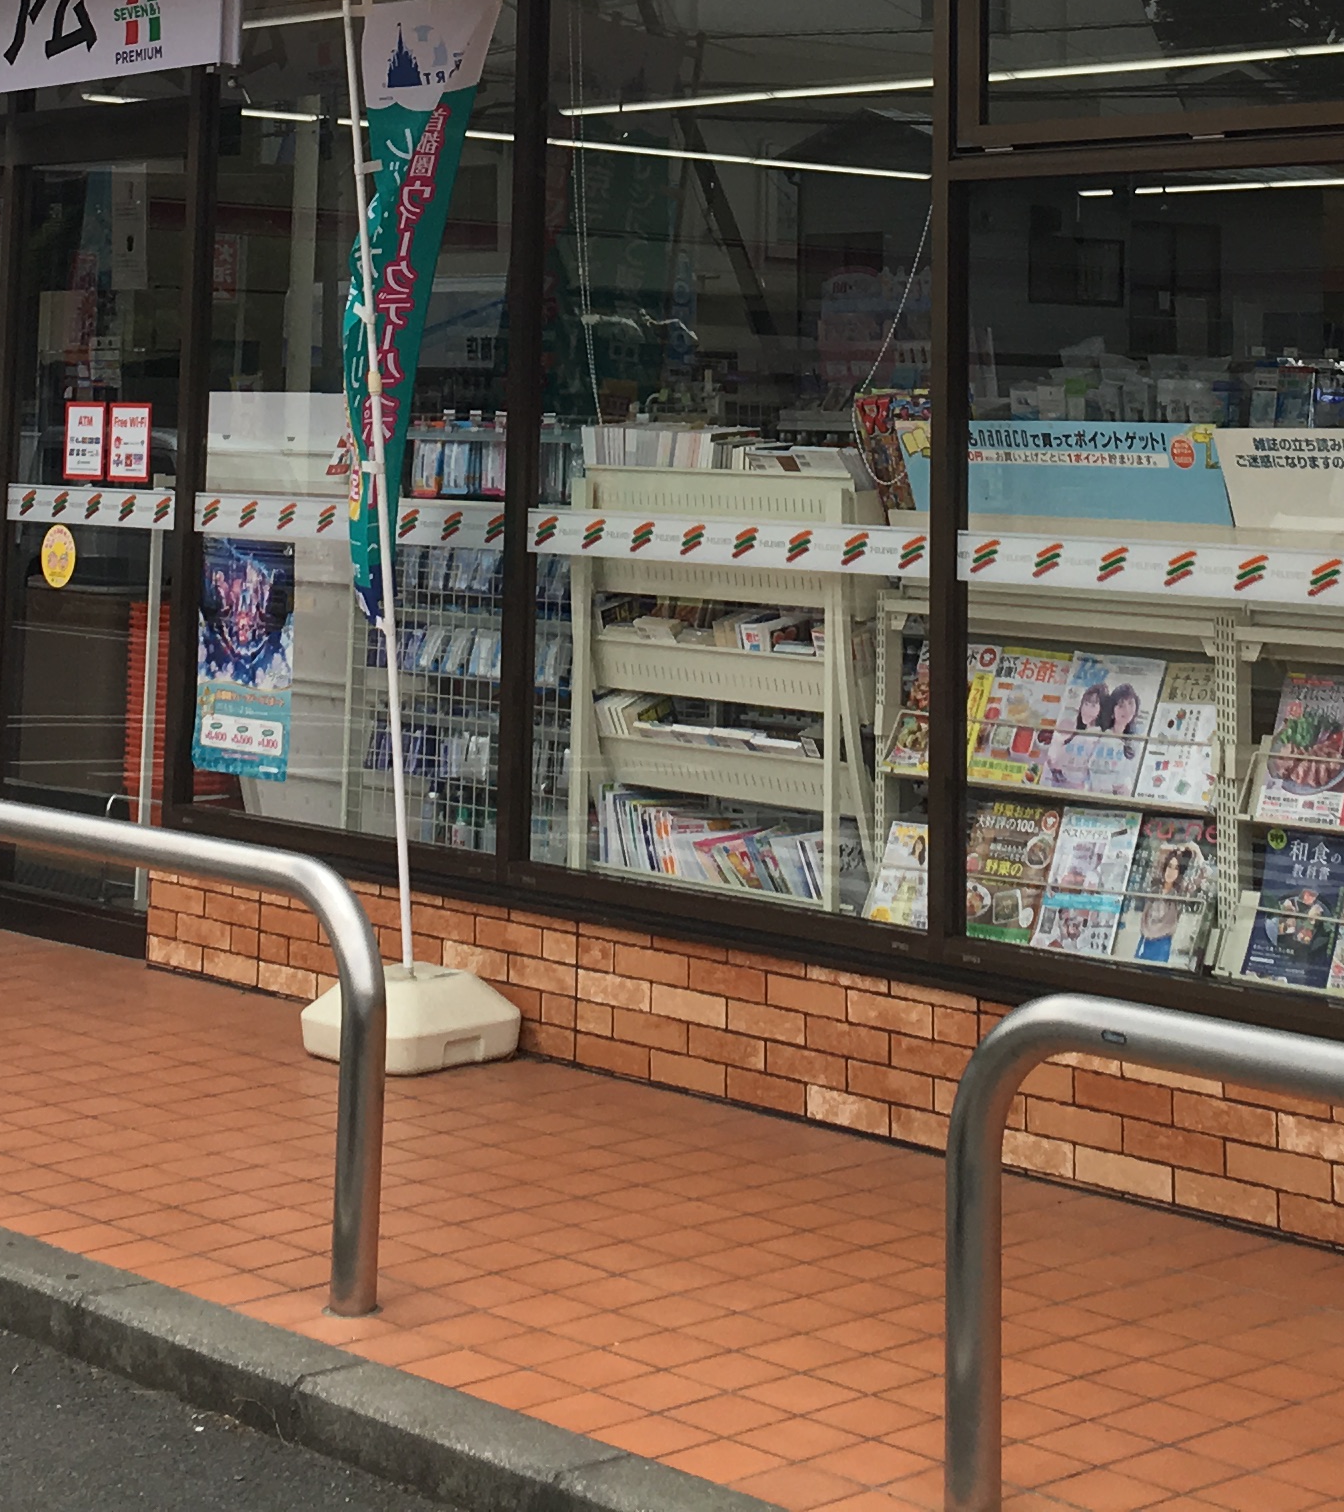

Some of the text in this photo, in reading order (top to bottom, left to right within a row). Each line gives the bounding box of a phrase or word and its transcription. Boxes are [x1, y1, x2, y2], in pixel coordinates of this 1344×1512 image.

[115, 46, 163, 65] PREMIUM
[77, 415, 94, 428] ATM
[114, 416, 128, 428] Free
[1017, 659, 1055, 684] お酢
[993, 802, 1044, 820] 野菜おかず
[1061, 827, 1110, 841] ベストアイテム
[1289, 838, 1342, 865] 和食の
[984, 858, 1024, 877] 野菜の
[1292, 864, 1331, 881] 教科書
